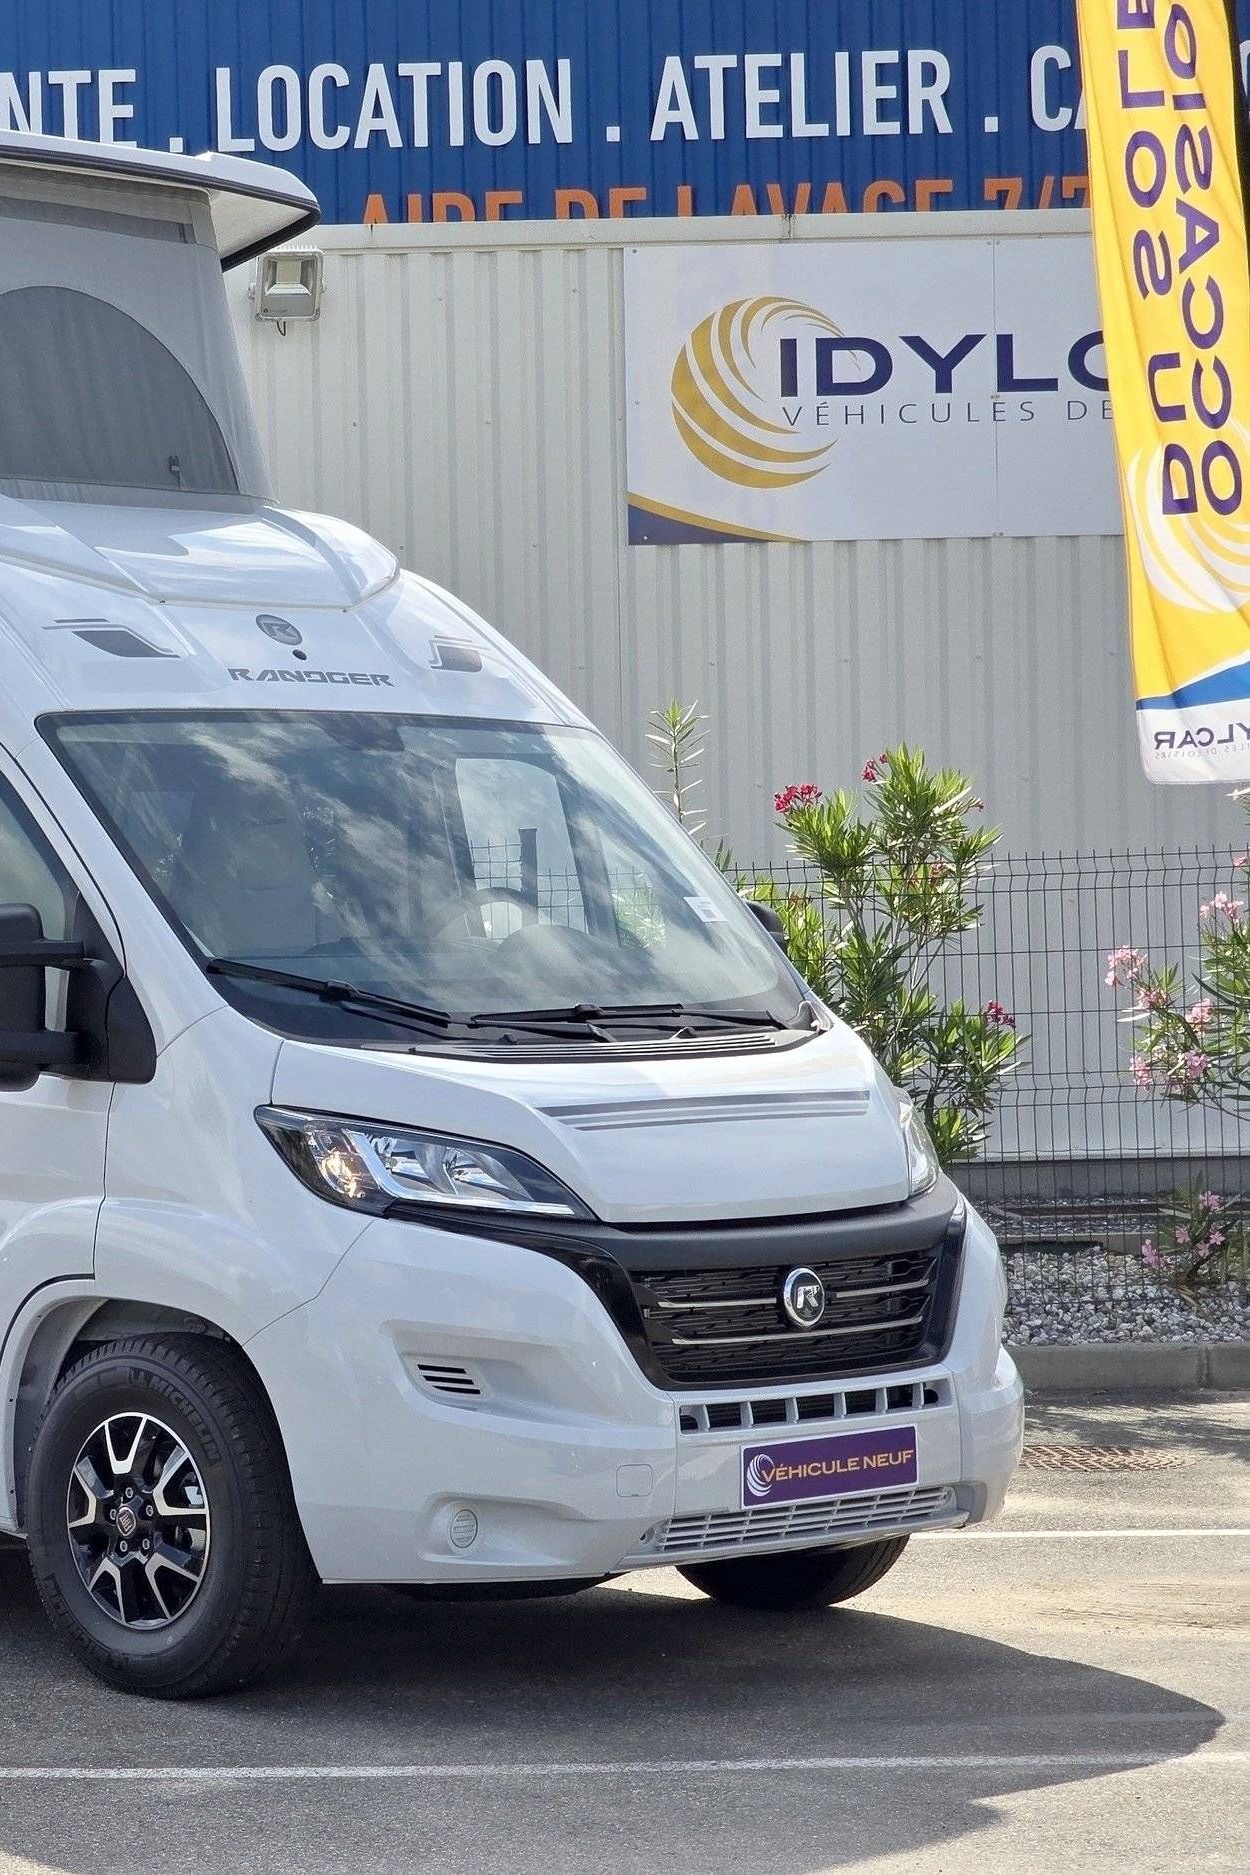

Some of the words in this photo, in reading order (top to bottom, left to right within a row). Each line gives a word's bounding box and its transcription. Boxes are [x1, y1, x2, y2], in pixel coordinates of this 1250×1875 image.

[215, 59, 573, 152] LOCATION
[650, 49, 953, 141] ATELIER
[782, 400, 1035, 426] VÉHICULES
[1067, 399, 1115, 421] DE
[761, 1457, 860, 1482] VÉHICULE
[863, 1449, 914, 1469] NEUF
